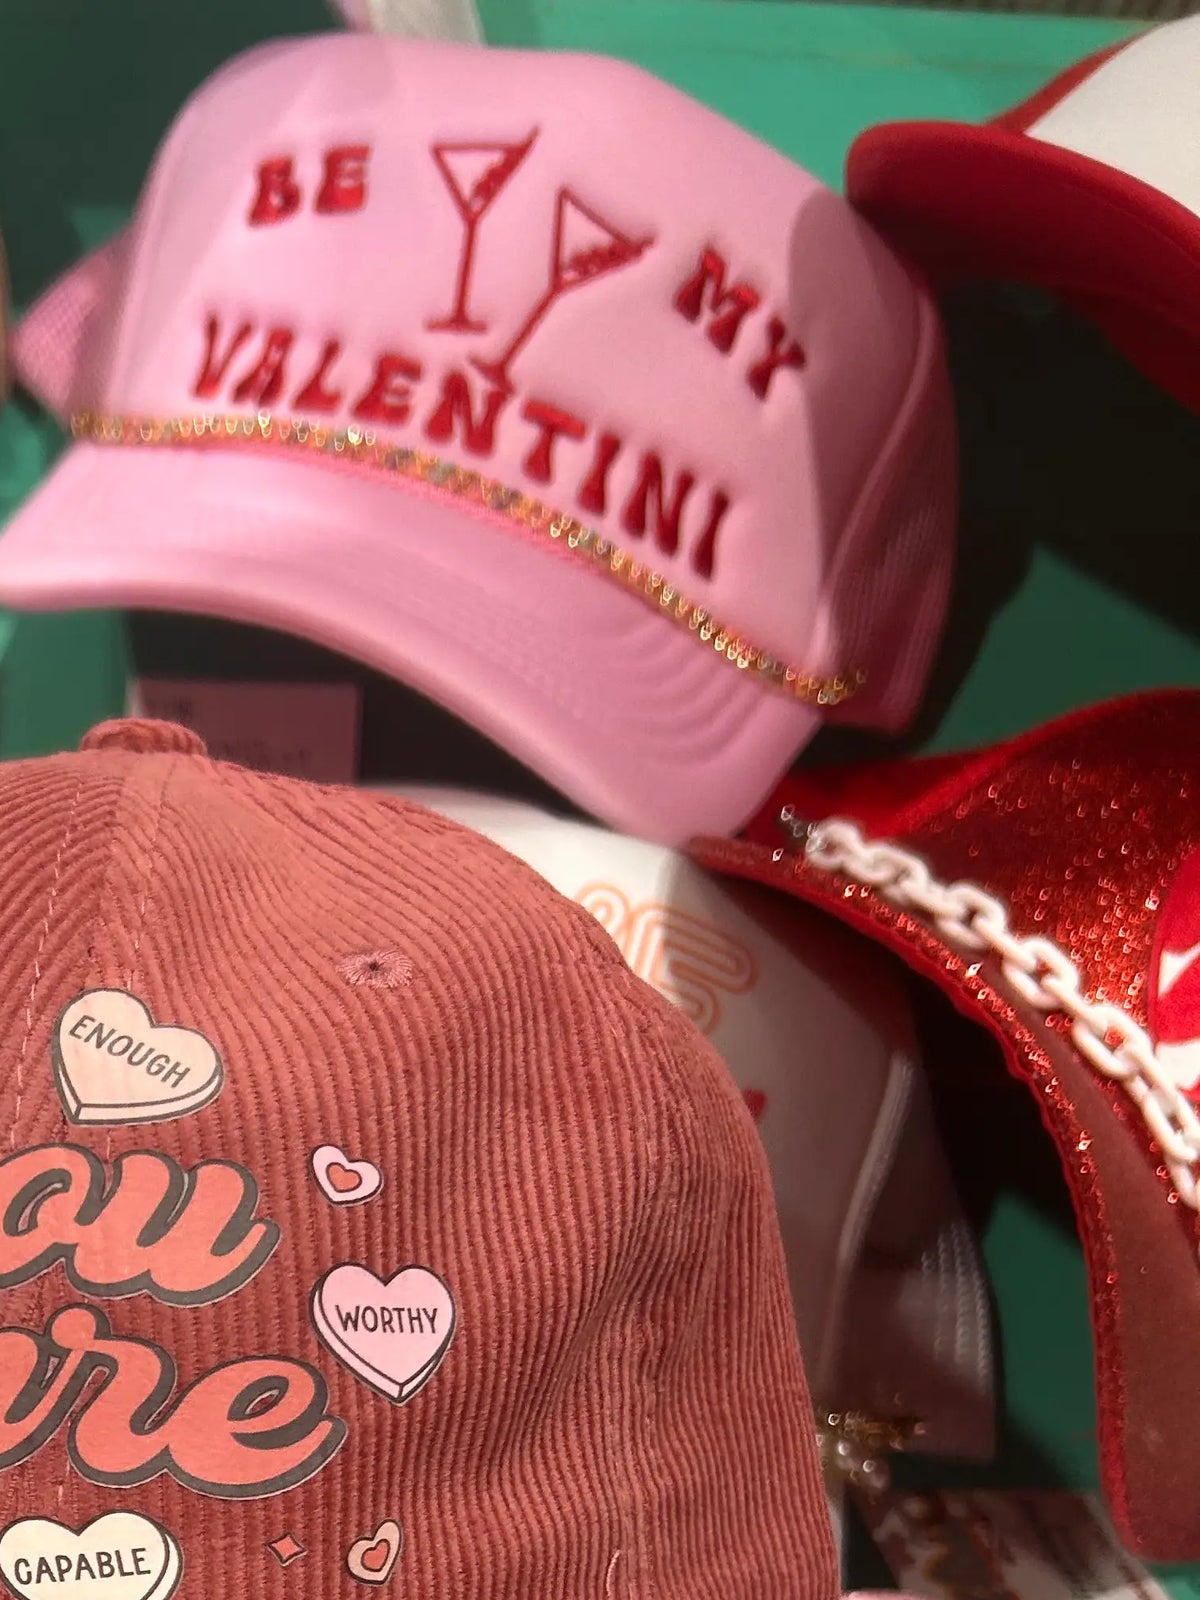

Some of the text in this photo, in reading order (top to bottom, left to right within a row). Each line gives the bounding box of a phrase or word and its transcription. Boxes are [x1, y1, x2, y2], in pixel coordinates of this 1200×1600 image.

[248, 145, 808, 402] BE MY
[191, 311, 733, 581] VALENTINI
[68, 1014, 192, 1089] ENOUGH
[334, 1304, 439, 1334] WORTHY
[13, 1547, 152, 1585] CAPABLE
